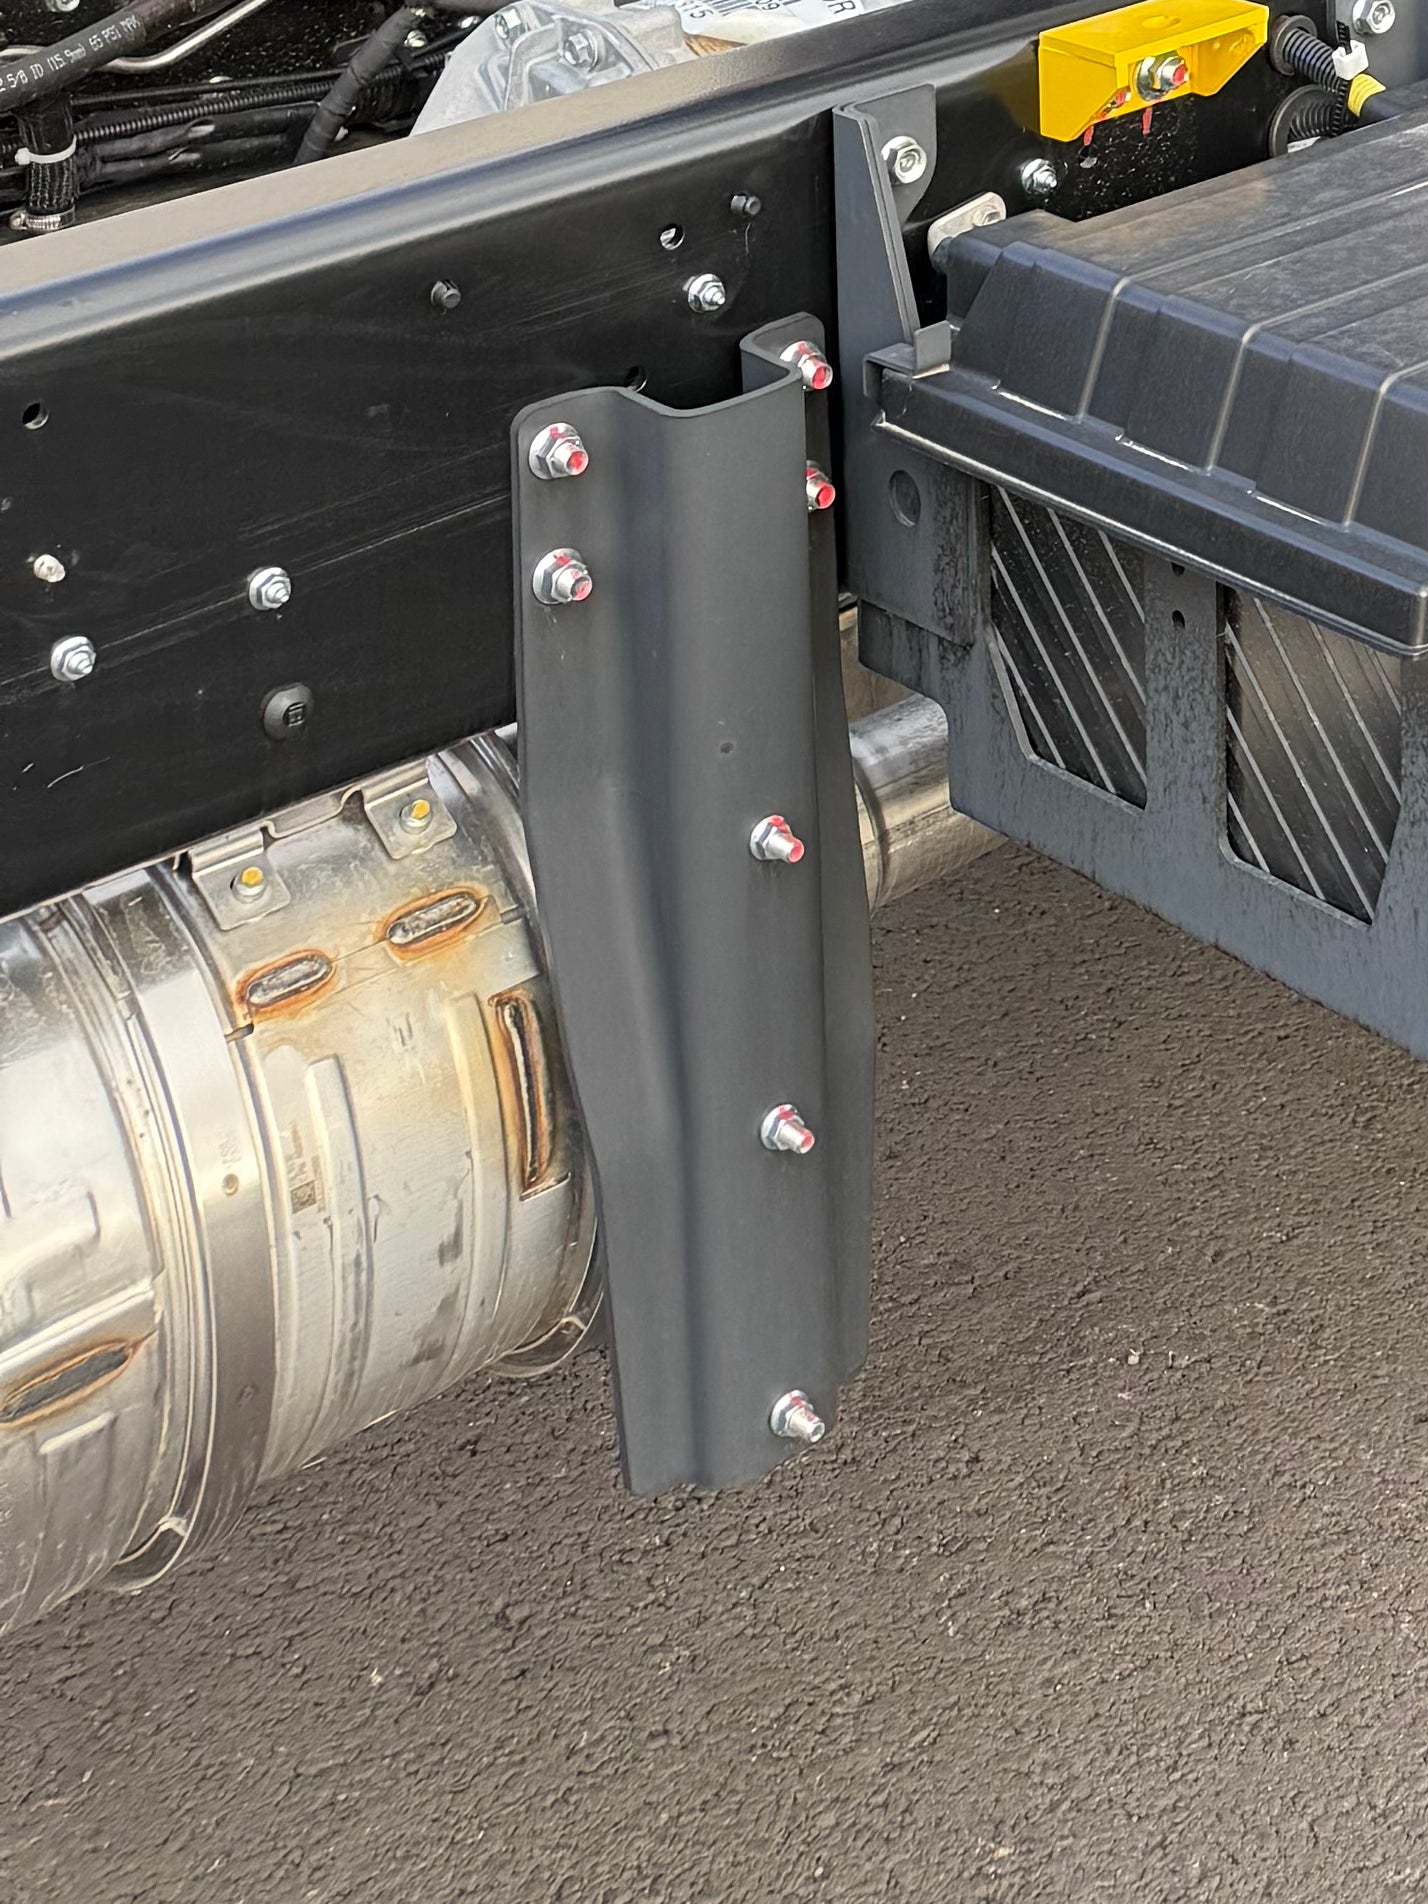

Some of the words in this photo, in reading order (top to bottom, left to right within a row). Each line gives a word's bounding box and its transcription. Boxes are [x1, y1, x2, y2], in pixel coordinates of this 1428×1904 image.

[8, 66, 28, 89] 5/8
[30, 63, 44, 82] ID
[102, 24, 123, 46] PSI
